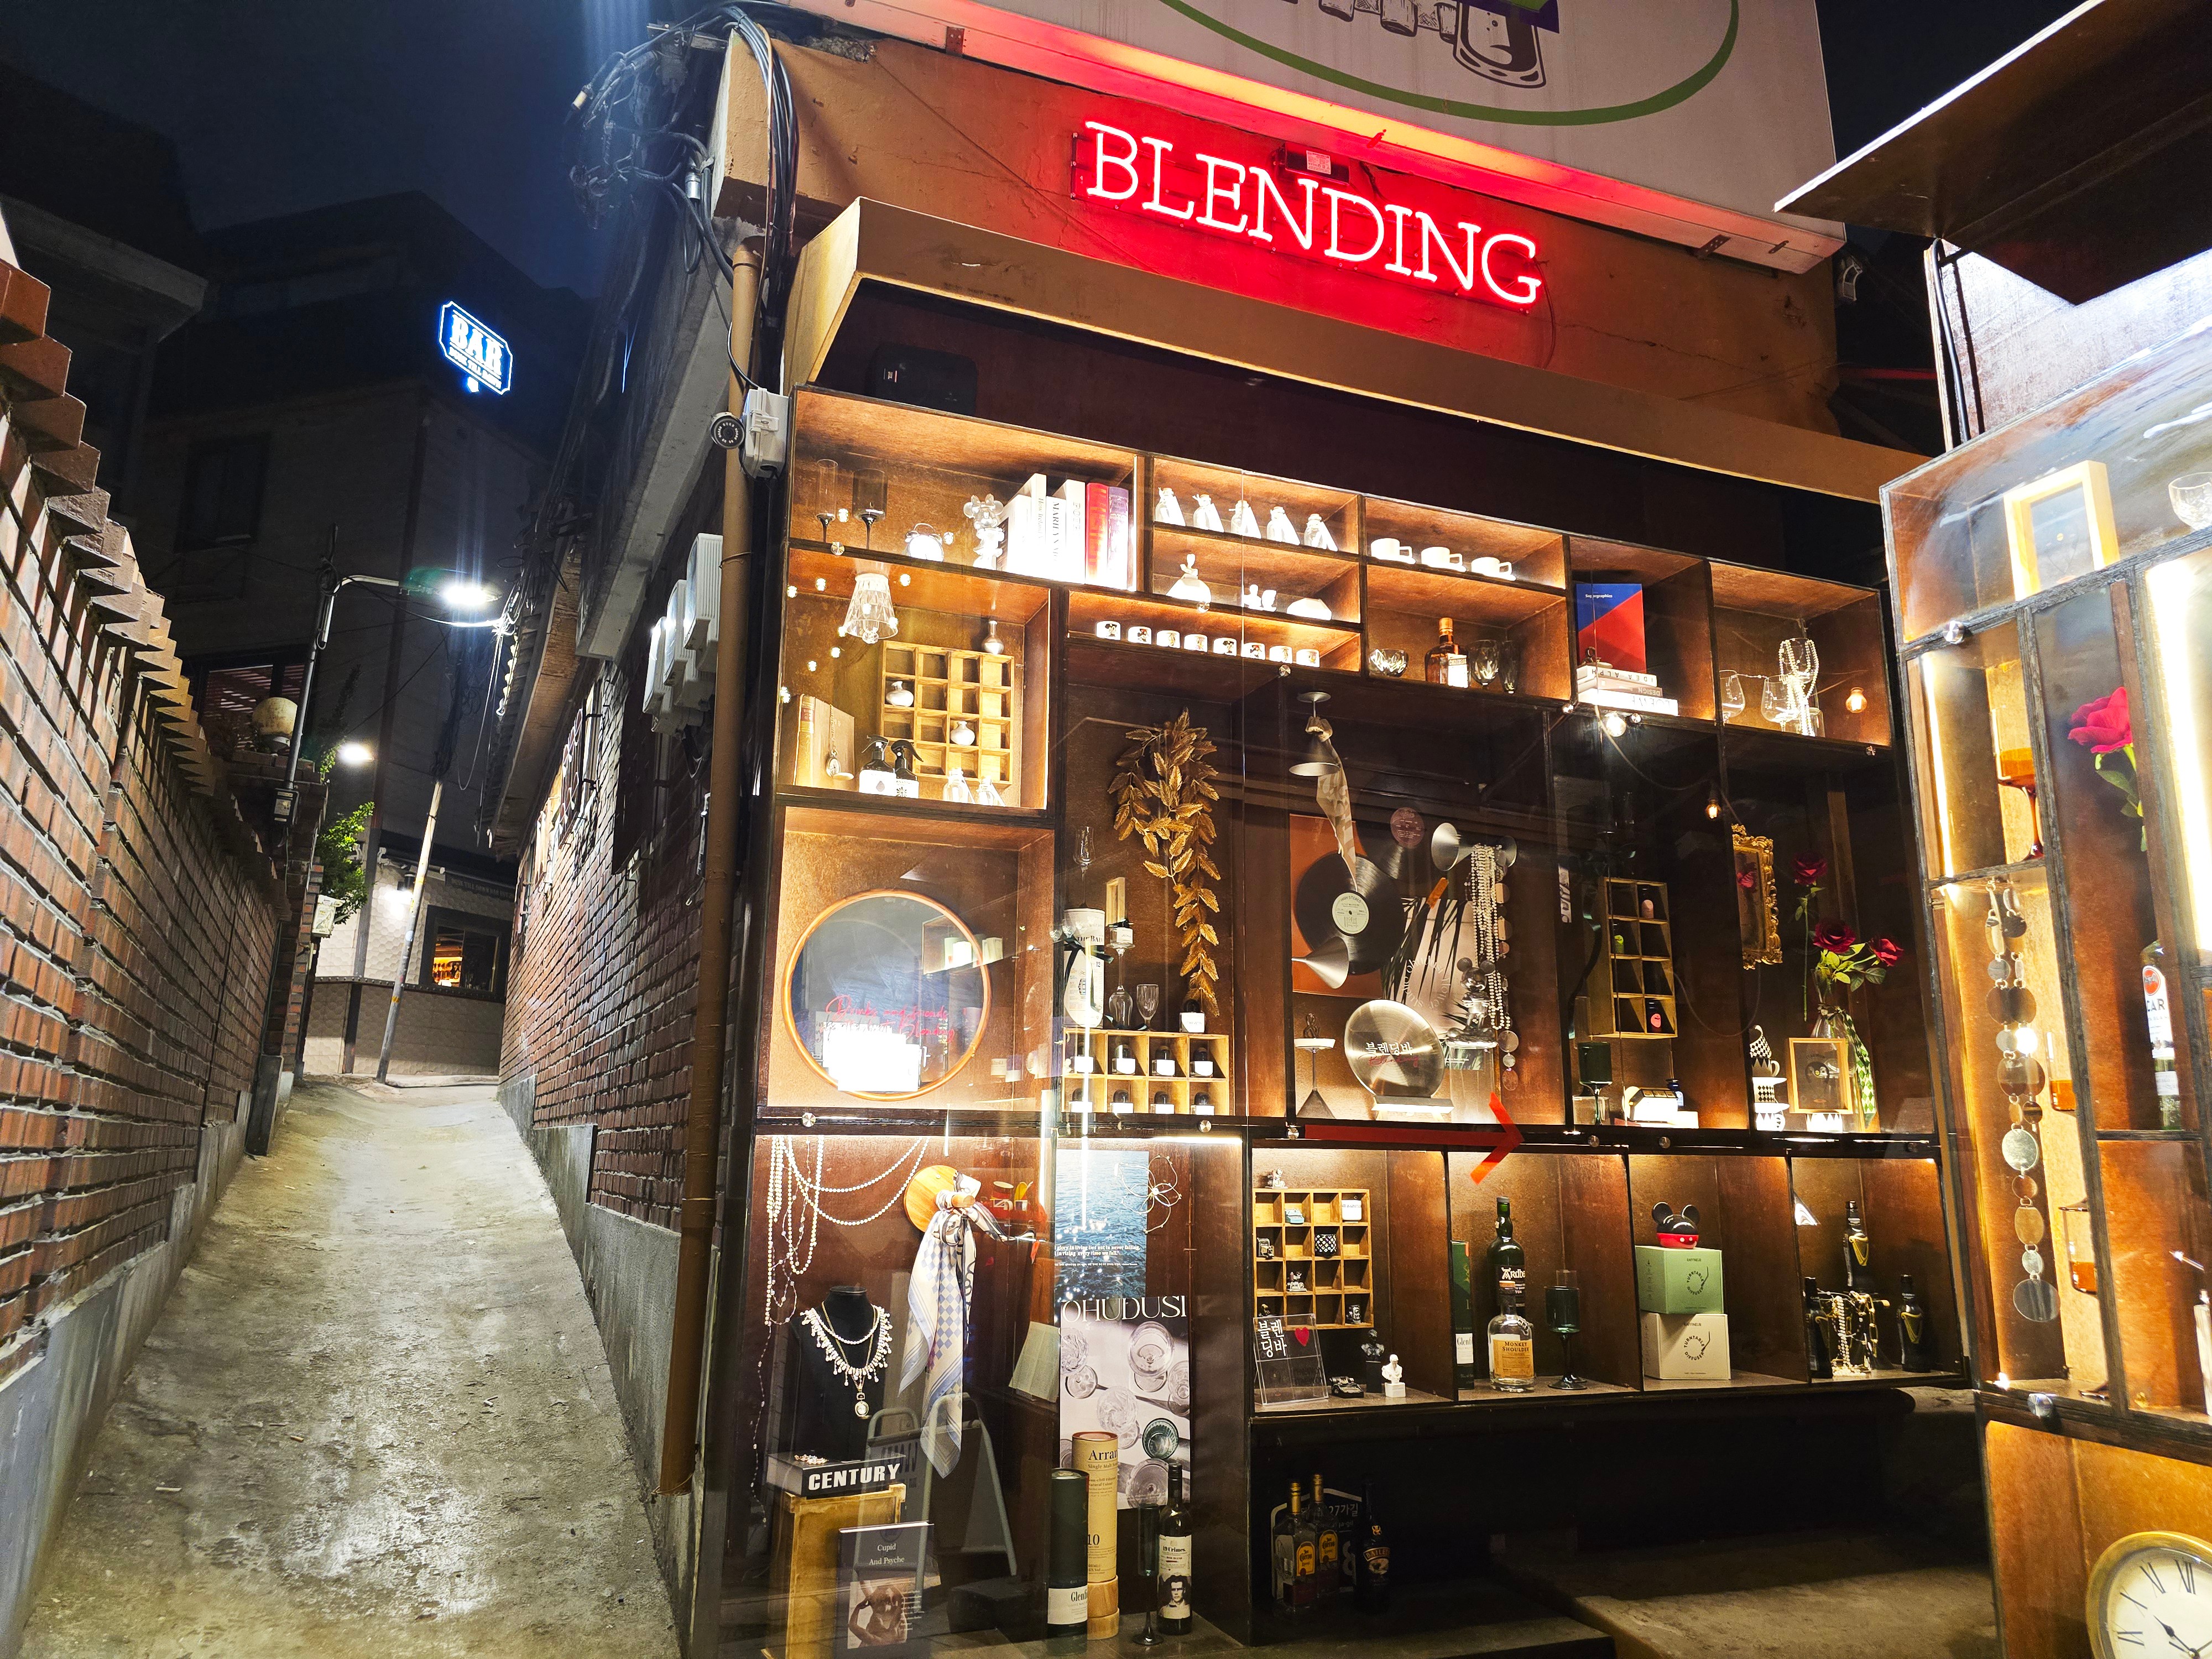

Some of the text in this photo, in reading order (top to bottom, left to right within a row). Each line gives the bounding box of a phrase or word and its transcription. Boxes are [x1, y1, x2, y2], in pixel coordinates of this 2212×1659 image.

[1086, 121, 1541, 305] BLENDING
[450, 314, 502, 375] BAR
[1628, 674, 1653, 684] IDEA
[1638, 686, 1661, 696] DESIGN
[1365, 1042, 1414, 1056] 블렌딩바
[1687, 1270, 1704, 1283] TURNTABLE
[1062, 1295, 1187, 1323] OHUDUSI
[1258, 1319, 1285, 1339] 블렌
[1260, 1337, 1287, 1358] 딩바
[1683, 1335, 1705, 1348] TURNTABLE
[1684, 1351, 1704, 1361] DIFFUSER
[808, 1463, 901, 1491] CENTURY
[1087, 1534, 1100, 1546] 10
[877, 1543, 897, 1552] Cupid
[868, 1556, 905, 1566] And Psyche
